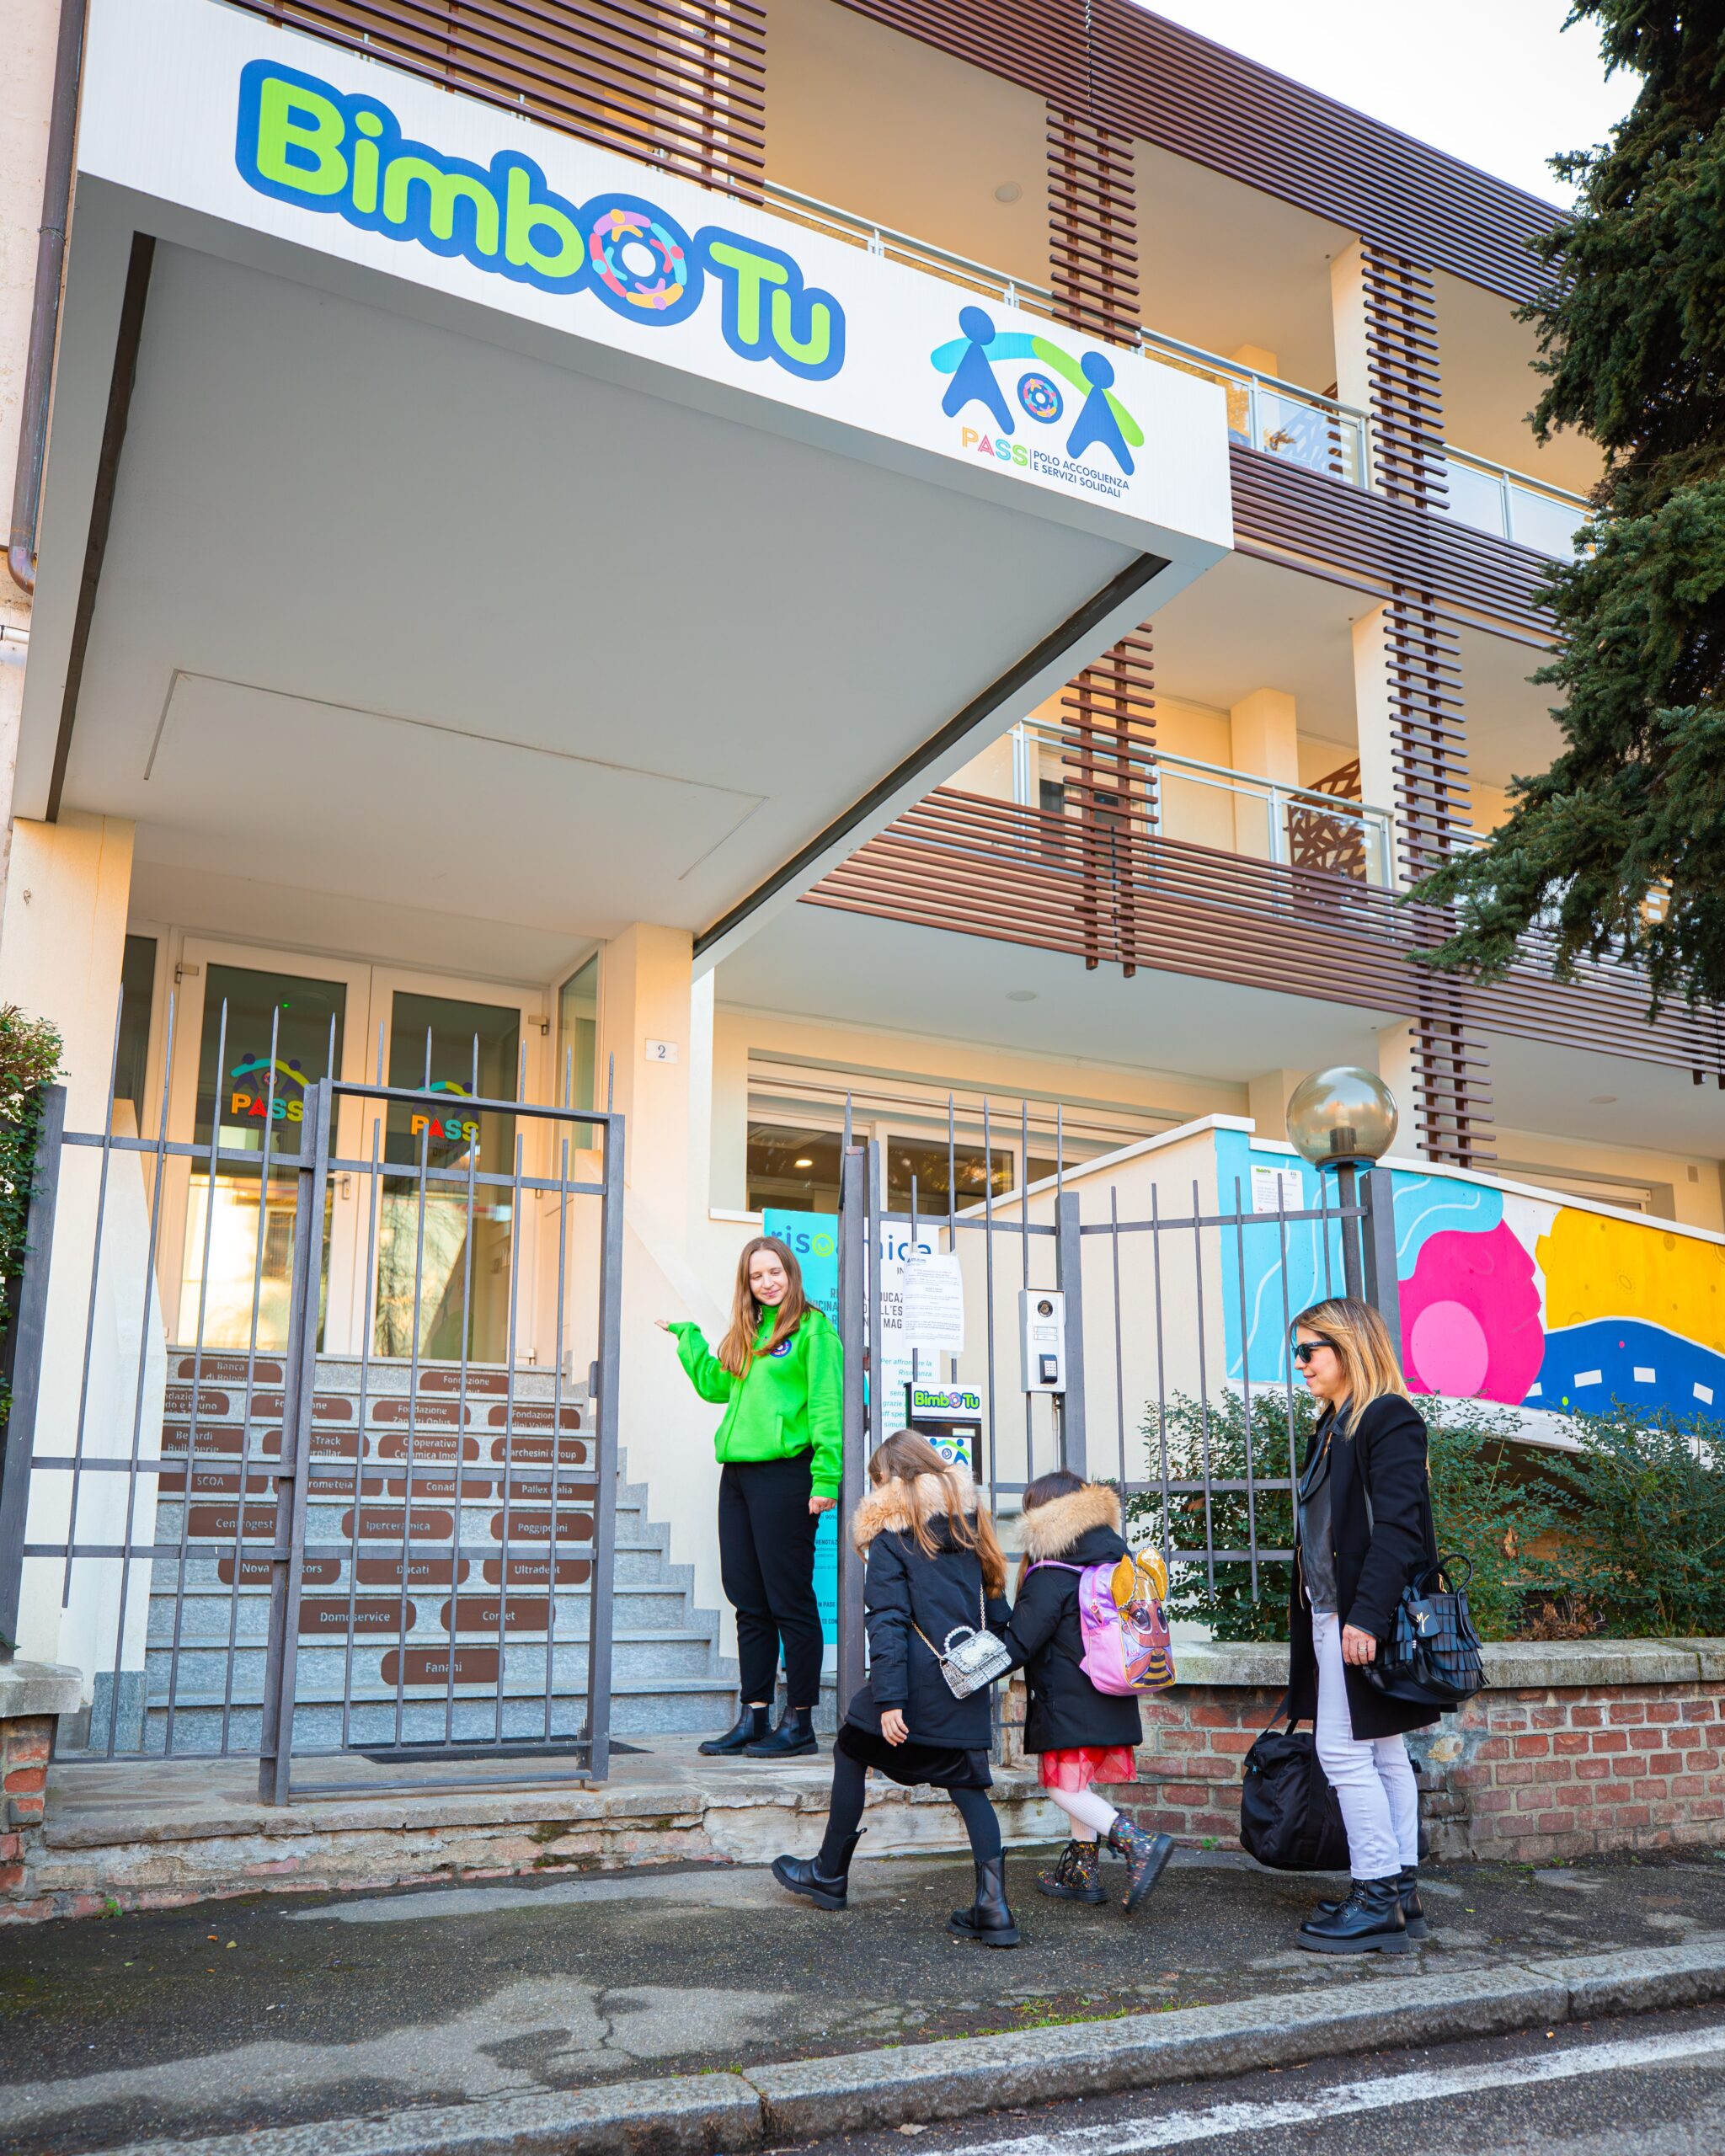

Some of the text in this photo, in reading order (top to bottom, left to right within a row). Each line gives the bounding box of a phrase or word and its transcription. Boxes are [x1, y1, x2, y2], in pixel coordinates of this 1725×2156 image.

[962, 426, 1028, 467] PASS
[1033, 451, 1130, 490] POLO ACCOGLIENZA
[1033, 462, 1121, 498] E SERVIZI SOLIDALI
[658, 1045, 665, 1059] 2
[231, 1092, 303, 1122] PASS
[410, 1113, 479, 1141] PASS
[216, 1361, 244, 1371] Banca
[398, 1404, 447, 1415] Fodazione
[403, 1438, 457, 1449] Coperativa
[197, 1476, 224, 1486] SCOA
[309, 1481, 353, 1490] rometeia
[426, 1481, 455, 1492] Conad
[522, 1485, 547, 1494] Pallex
[518, 1523, 568, 1534] Poggipoini
[242, 1563, 270, 1573] Nova
[515, 1565, 561, 1574] Ultradet
